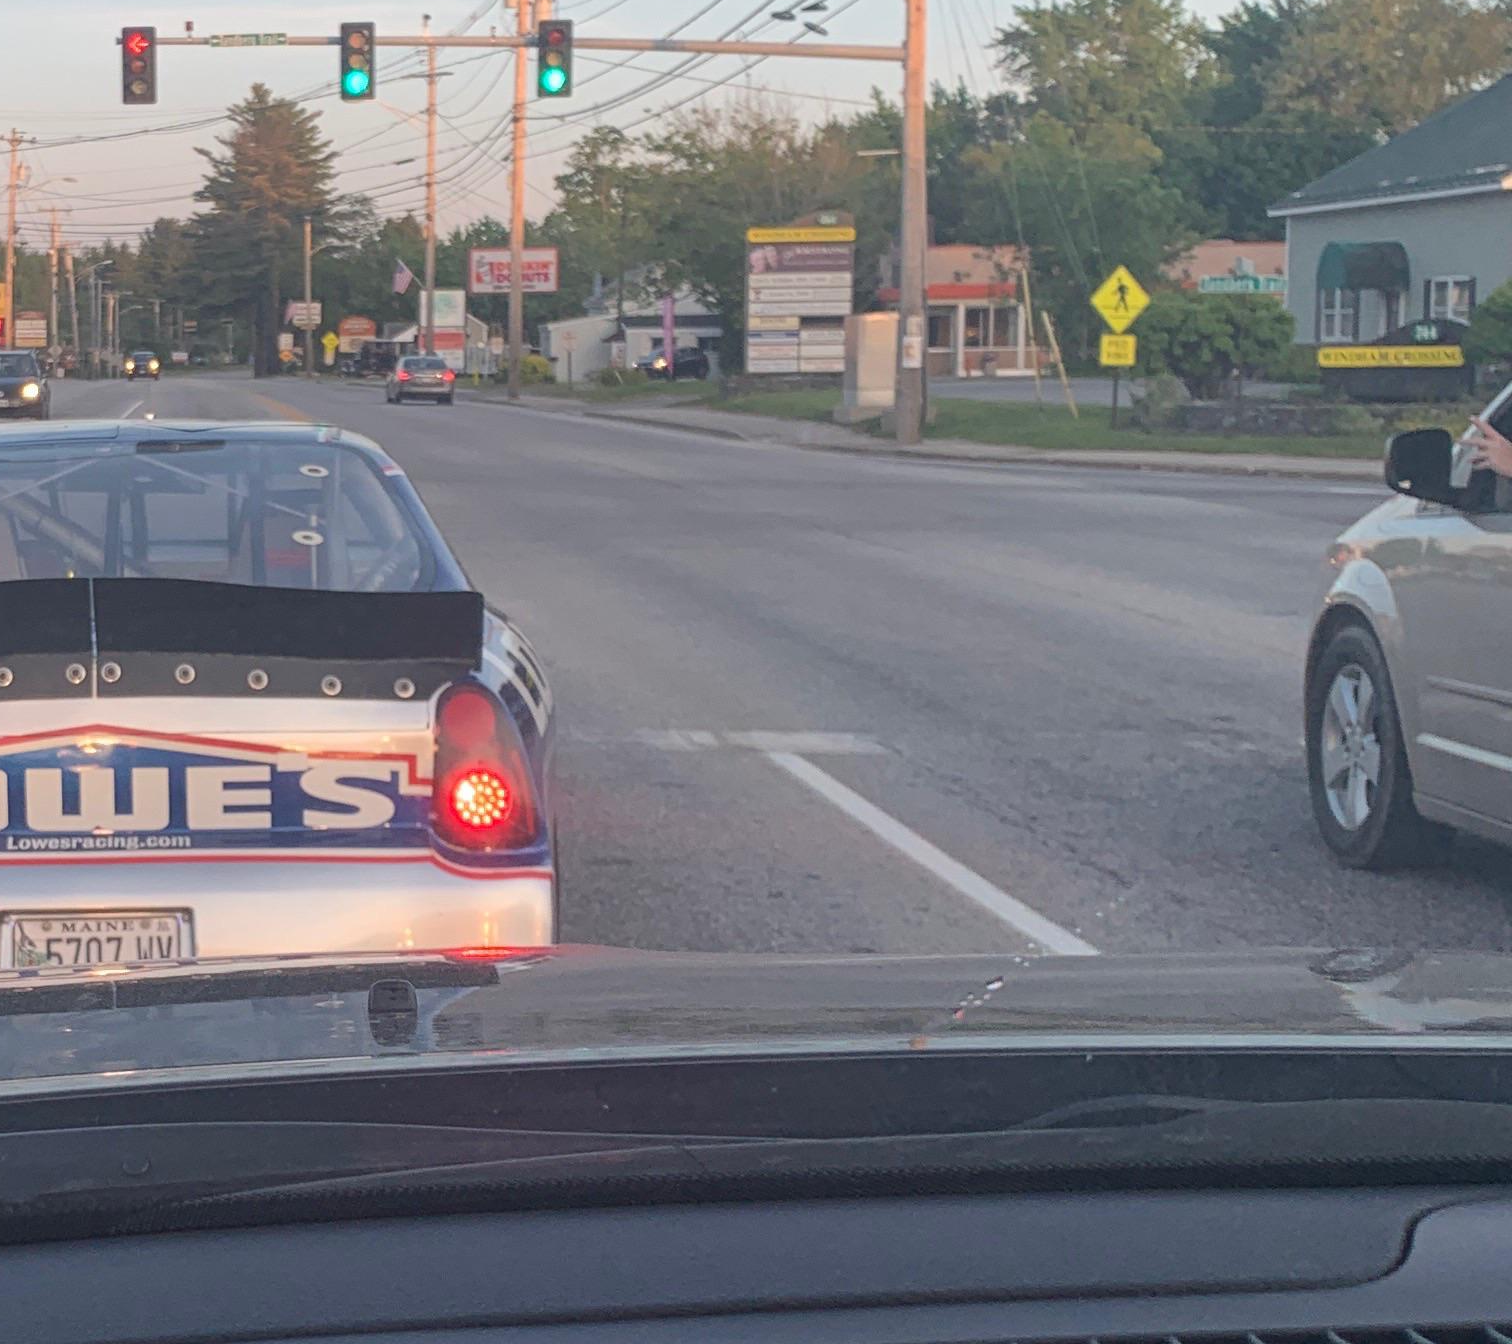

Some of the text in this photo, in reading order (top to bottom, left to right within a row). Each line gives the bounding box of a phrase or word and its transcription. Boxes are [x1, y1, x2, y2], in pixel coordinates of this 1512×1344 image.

[494, 261, 554, 272] DUKIN'
[494, 272, 550, 284] DOUTS
[6, 835, 192, 851] Lowesracing.com
[61, 920, 133, 933] MAINE
